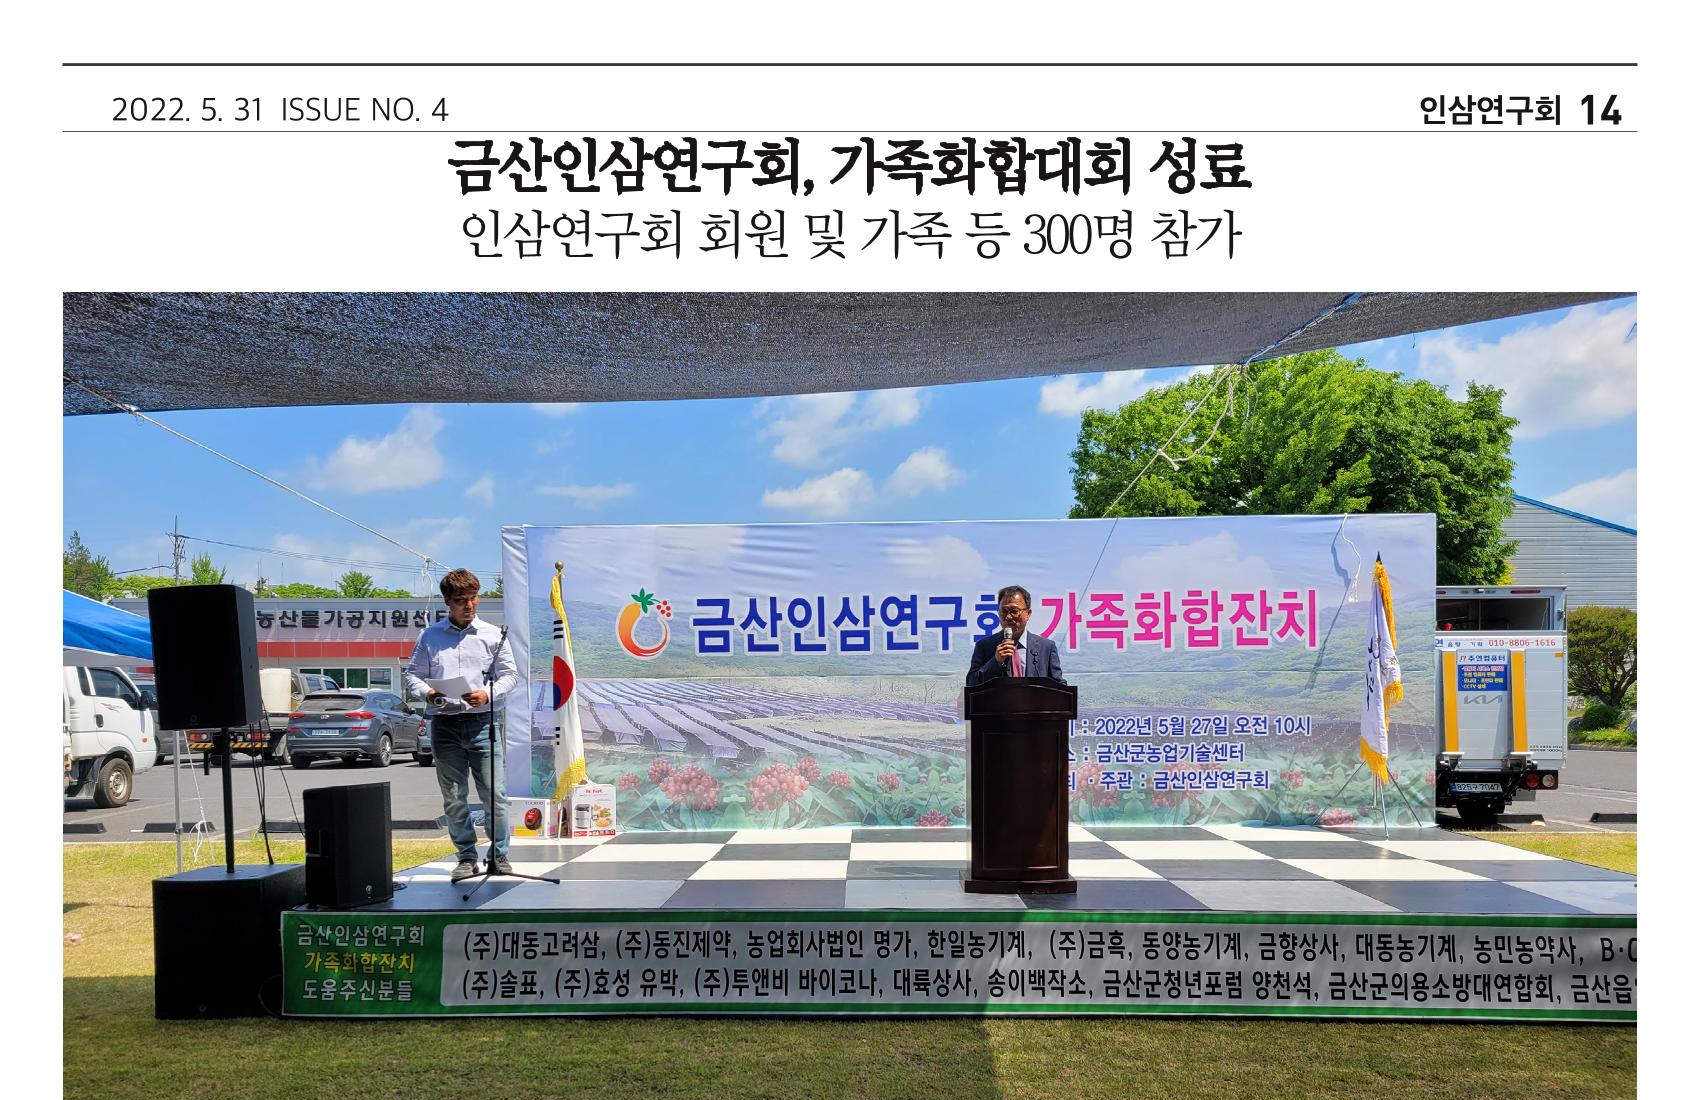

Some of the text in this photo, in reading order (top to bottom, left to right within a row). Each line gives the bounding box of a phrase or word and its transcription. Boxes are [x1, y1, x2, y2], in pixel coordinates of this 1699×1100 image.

[112, 97, 449, 122] 2022. 5. 31 ISSUE NO. 4
[1420, 94, 1622, 126] 인삼연구회 14
[447, 136, 1253, 197] 금산인삼연구회, 가족화합대회 성료
[462, 209, 1243, 260] 인삼연구회 회원 및 가족 등 300명 참가
[1041, 590, 1317, 650] 가족화합잔치
[1488, 639, 1556, 647] 010-8806-1616
[1095, 717, 1152, 736] 2022년
[1158, 717, 1185, 735] 5월
[1191, 717, 1228, 735] 27일
[1234, 716, 1268, 735] 오전
[1275, 716, 1312, 734] 10시
[1096, 743, 1244, 763] 금산군농업기술센터
[1100, 771, 1270, 790] 주관 금산인삼연구회
[297, 925, 425, 947] 금산인삼연구회
[464, 930, 605, 961] (주)대동고려삼,
[616, 930, 737, 960] (주)동진제약,
[746, 929, 865, 959] 농업회사법인
[874, 929, 918, 960] 명가,
[928, 929, 1033, 961] 한일농기계,
[1050, 929, 1133, 961] (주)금흑,
[1142, 931, 1250, 962] 동양농기계,
[1258, 932, 1346, 963] 금향상사,
[1356, 933, 1464, 964] 대동농기계,
[1474, 934, 1584, 966] 농민농약사,
[304, 951, 416, 975] 가족화합잔치
[302, 978, 414, 1002] 도움주신분들
[462, 968, 1637, 1005] (주)솔표, (주)효성 유박, (주)투앤비 바이코나, 대륙상사, 송이백작소, 금산군청년포럼 양천석, 금산군의용소방대연합회, 금산읍
